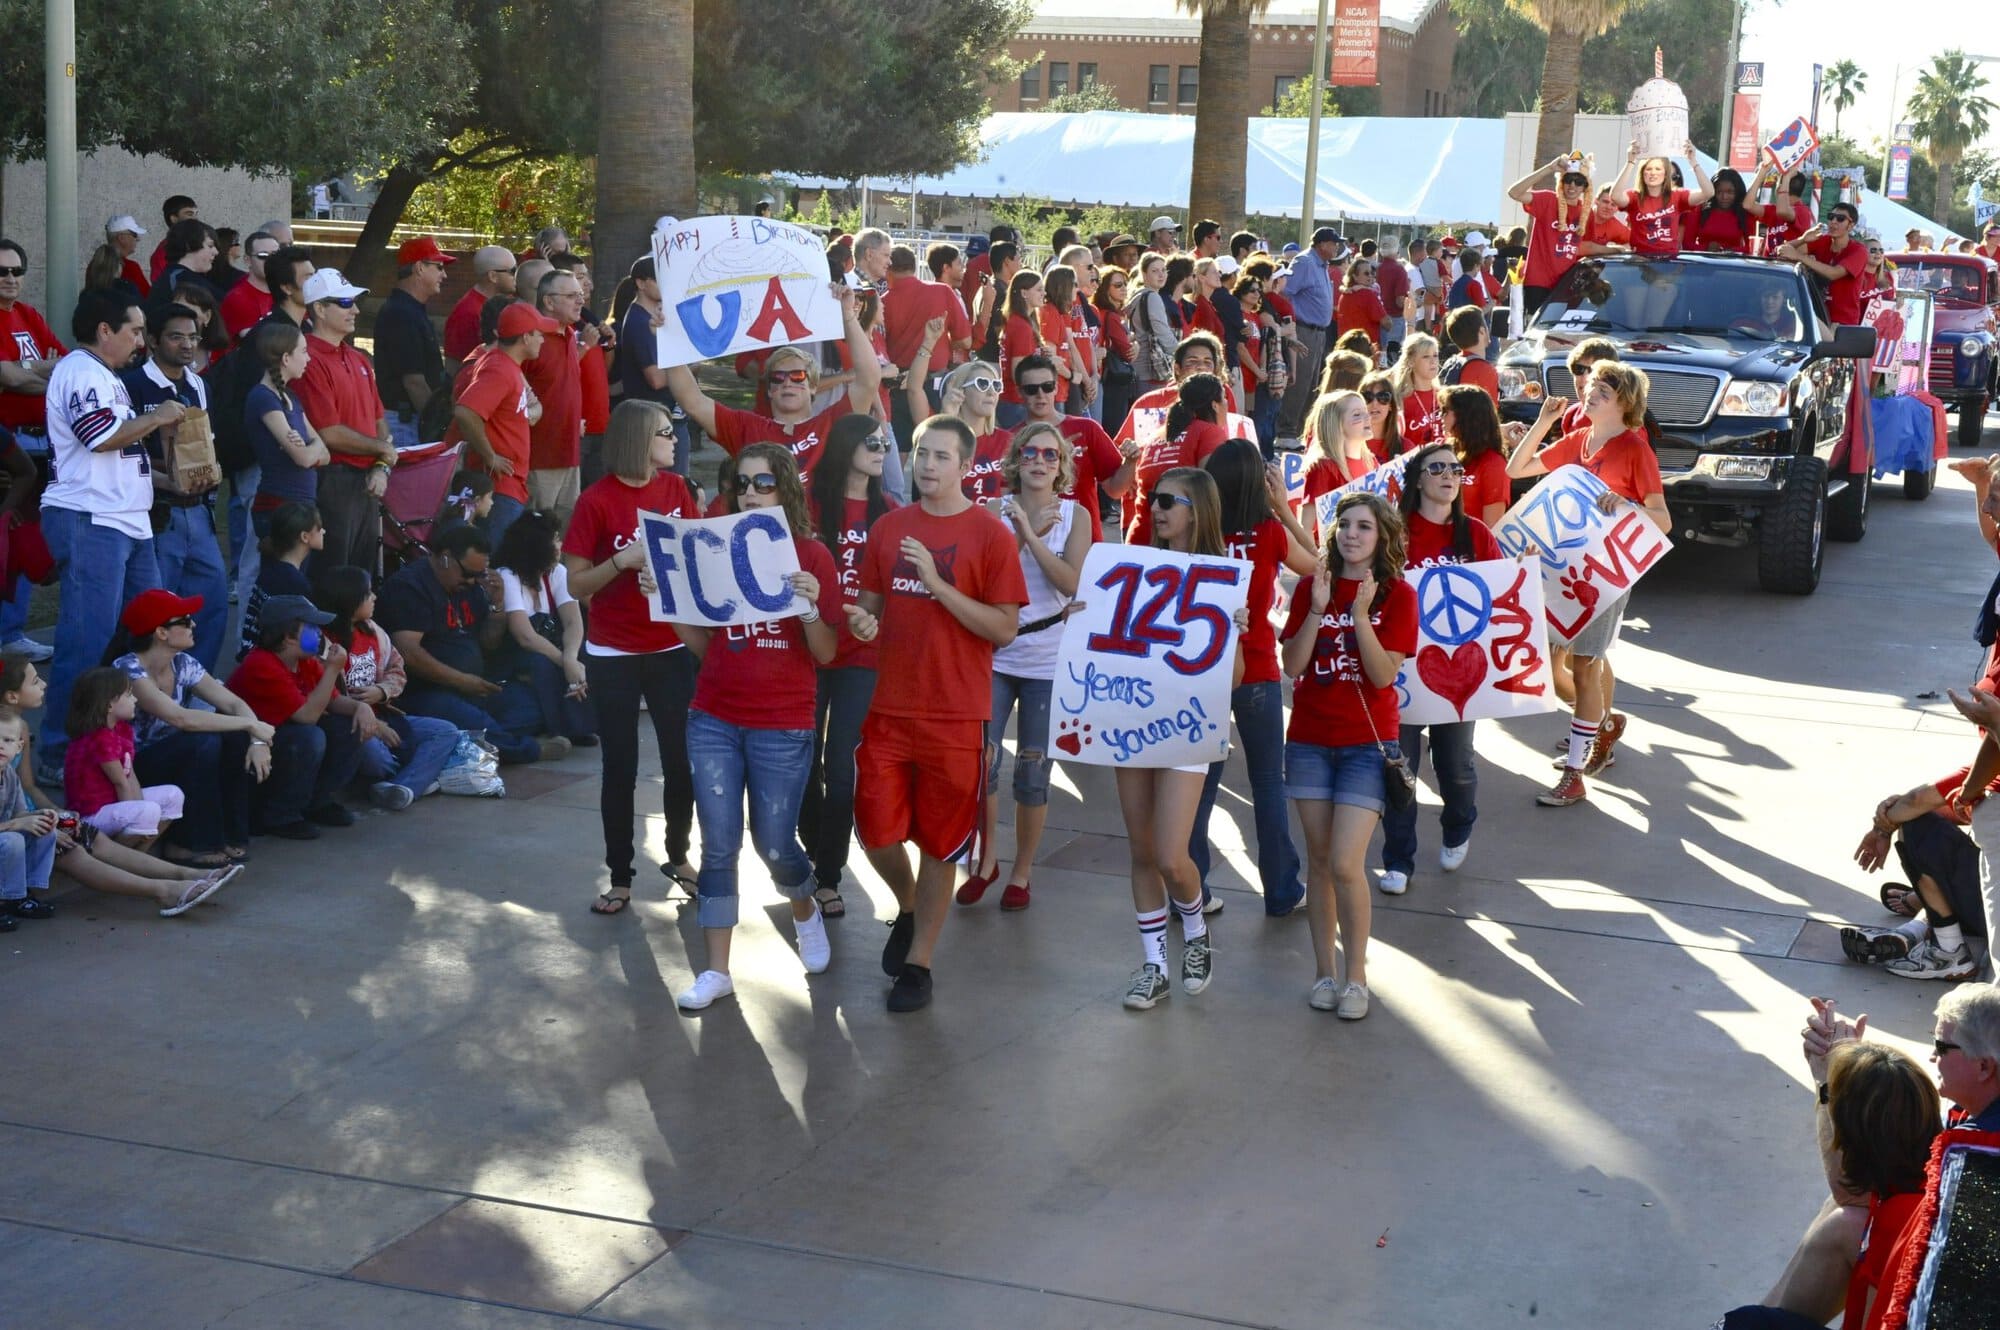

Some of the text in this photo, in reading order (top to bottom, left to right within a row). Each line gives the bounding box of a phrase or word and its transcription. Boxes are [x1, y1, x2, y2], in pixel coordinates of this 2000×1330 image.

[1345, 7, 1368, 17] NCAA
[1335, 17, 1378, 28] Champions
[1334, 48, 1376, 59] Swimming
[1647, 228, 1671, 240] LIFE
[1555, 245, 1577, 255] LIFE
[675, 290, 742, 358] U
[745, 275, 813, 344] A
[68, 387, 100, 413] 44
[187, 463, 213, 480] CHIPS
[973, 479, 984, 494] 4
[842, 548, 855, 567] 4
[643, 512, 797, 623] FCC
[1087, 561, 1240, 676] 125
[1334, 631, 1346, 652] 4
[1314, 653, 1360, 675] LIFE
